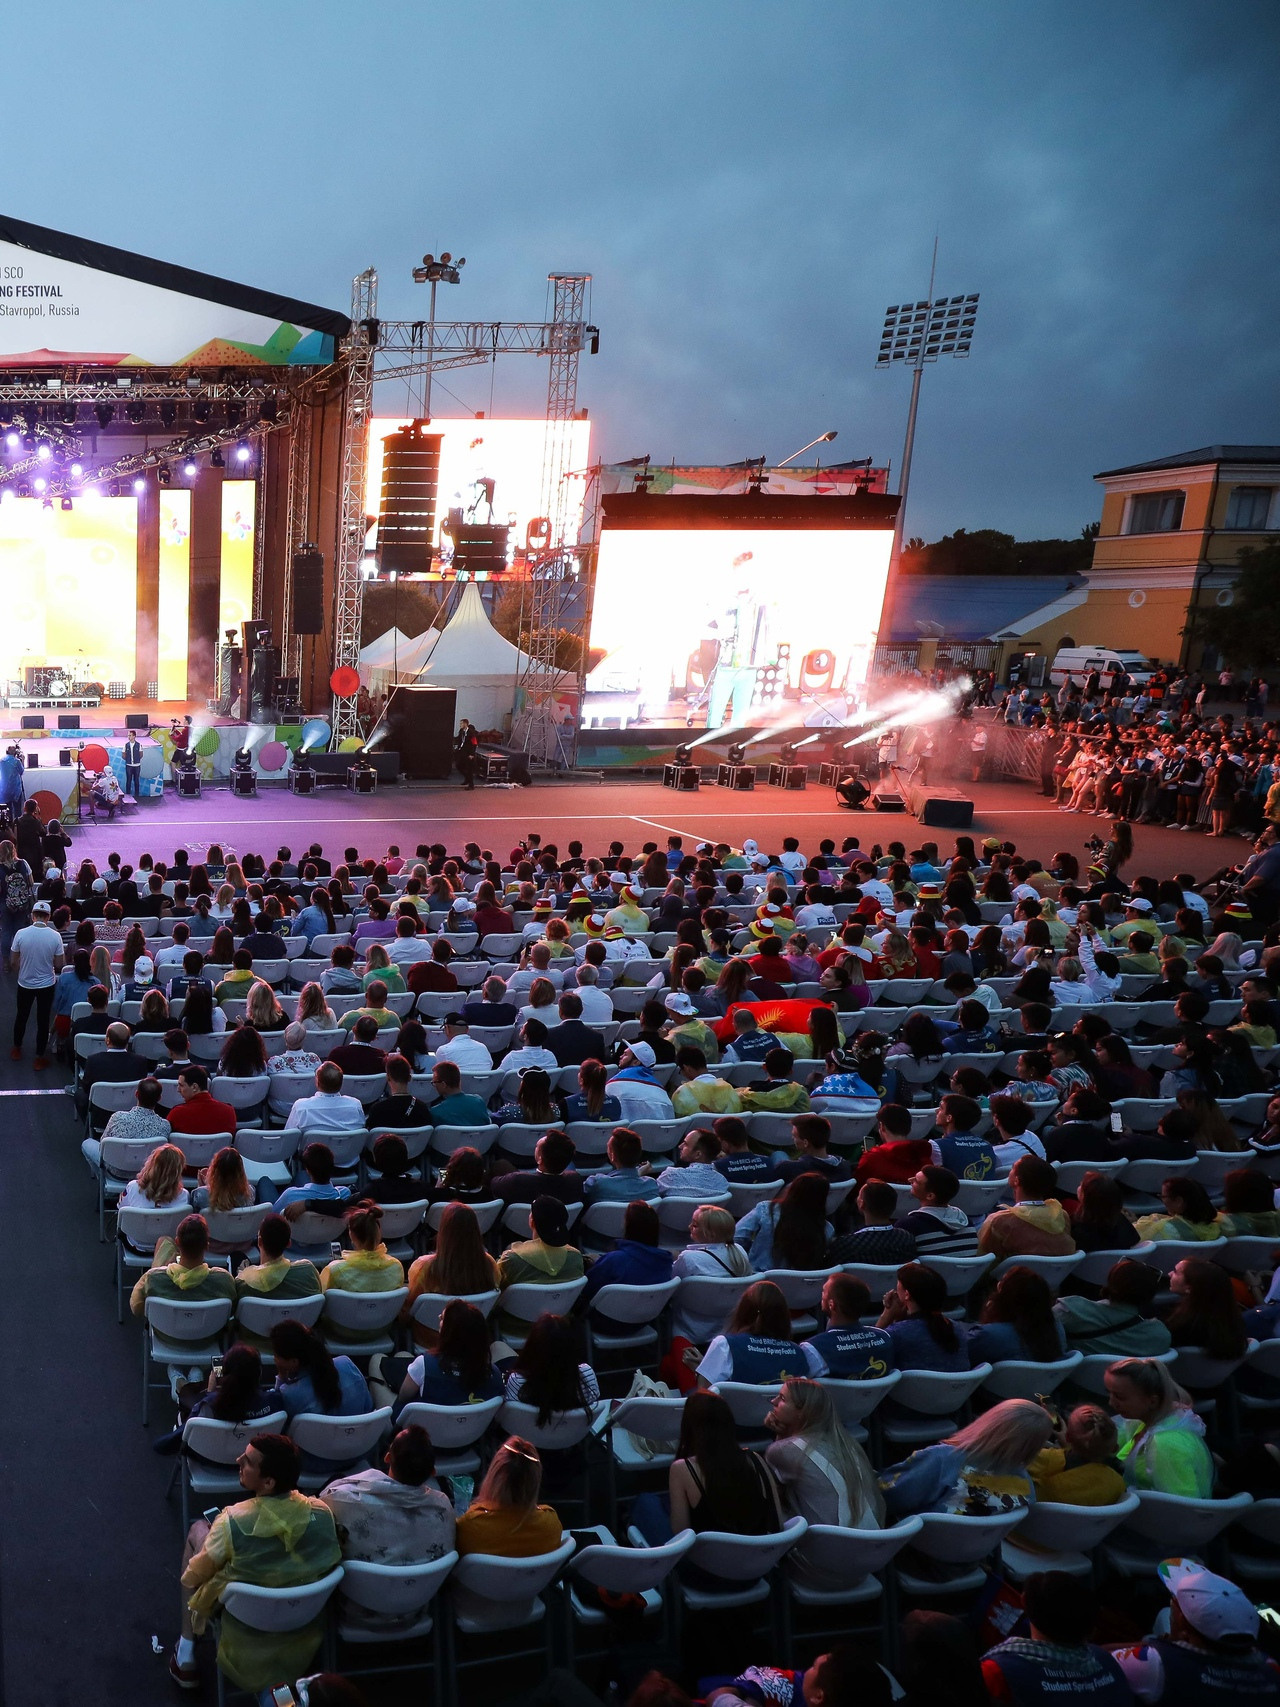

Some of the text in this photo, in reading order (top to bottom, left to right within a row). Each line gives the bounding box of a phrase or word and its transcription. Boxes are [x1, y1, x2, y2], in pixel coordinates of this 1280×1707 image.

[4, 266, 24, 279] SCO
[16, 285, 63, 297] FESTIVAL
[0, 304, 46, 319] Stavropol,
[48, 304, 80, 316] Russia
[747, 1344, 767, 1353] Student
[836, 1343, 857, 1351] Student
[1041, 1680, 1072, 1691] Student
